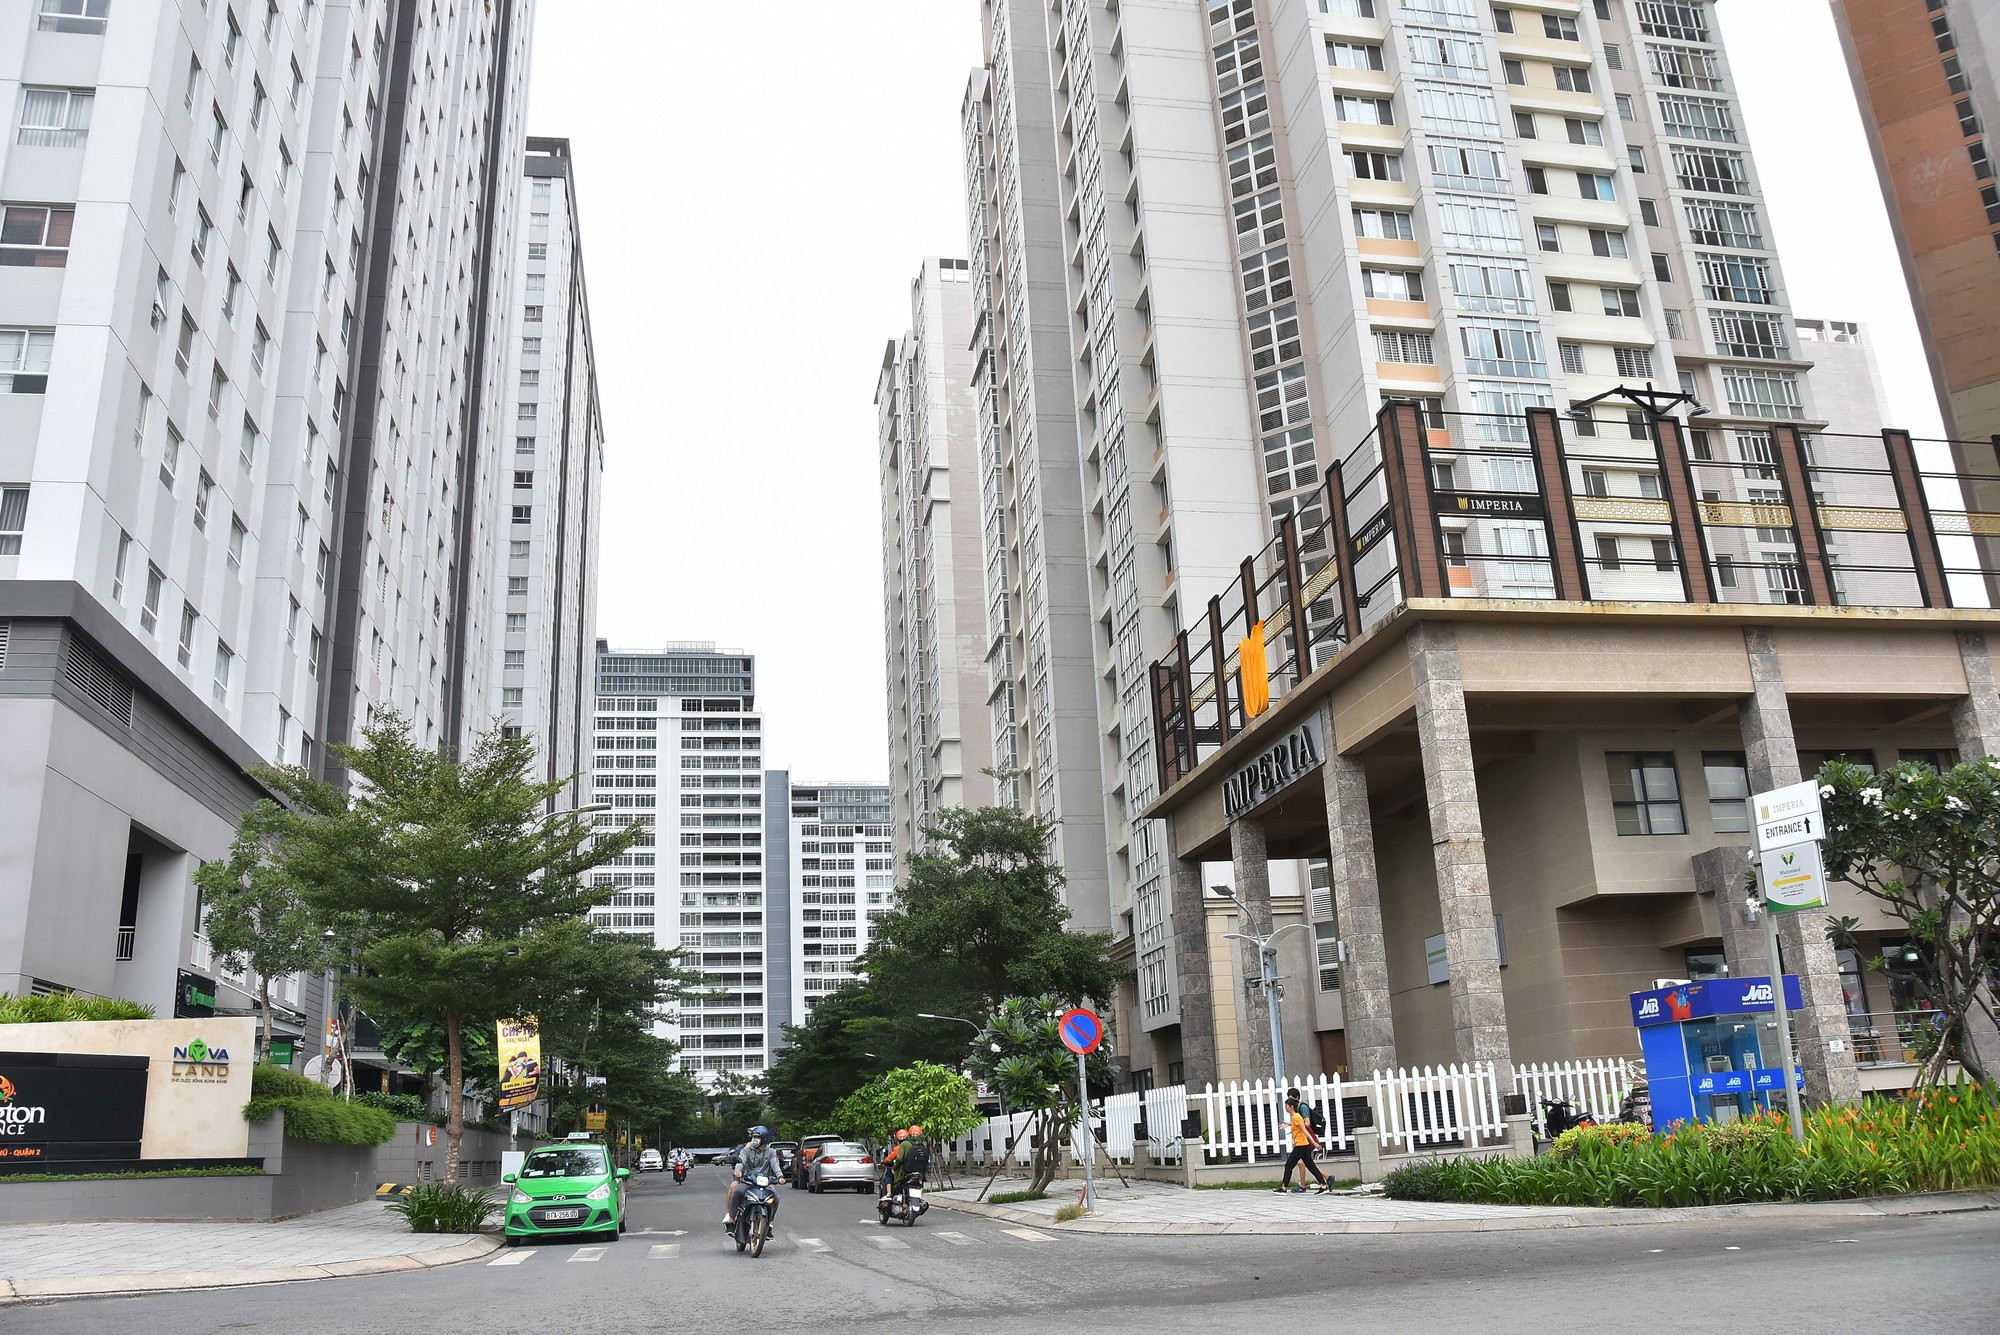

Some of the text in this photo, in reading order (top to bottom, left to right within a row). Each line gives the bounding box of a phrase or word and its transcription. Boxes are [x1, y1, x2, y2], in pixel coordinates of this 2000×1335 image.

[1470, 499, 1523, 511] IMPERIA
[1362, 518, 1386, 547] IMPERIA
[1221, 725, 1319, 818] IMPERIA
[1773, 799, 1805, 814] IMPERIA
[1765, 821, 1803, 839] ENTRANCE
[1741, 984, 1773, 1001] MB
[173, 1041, 229, 1061] NOVA
[172, 1063, 229, 1077] LAND
